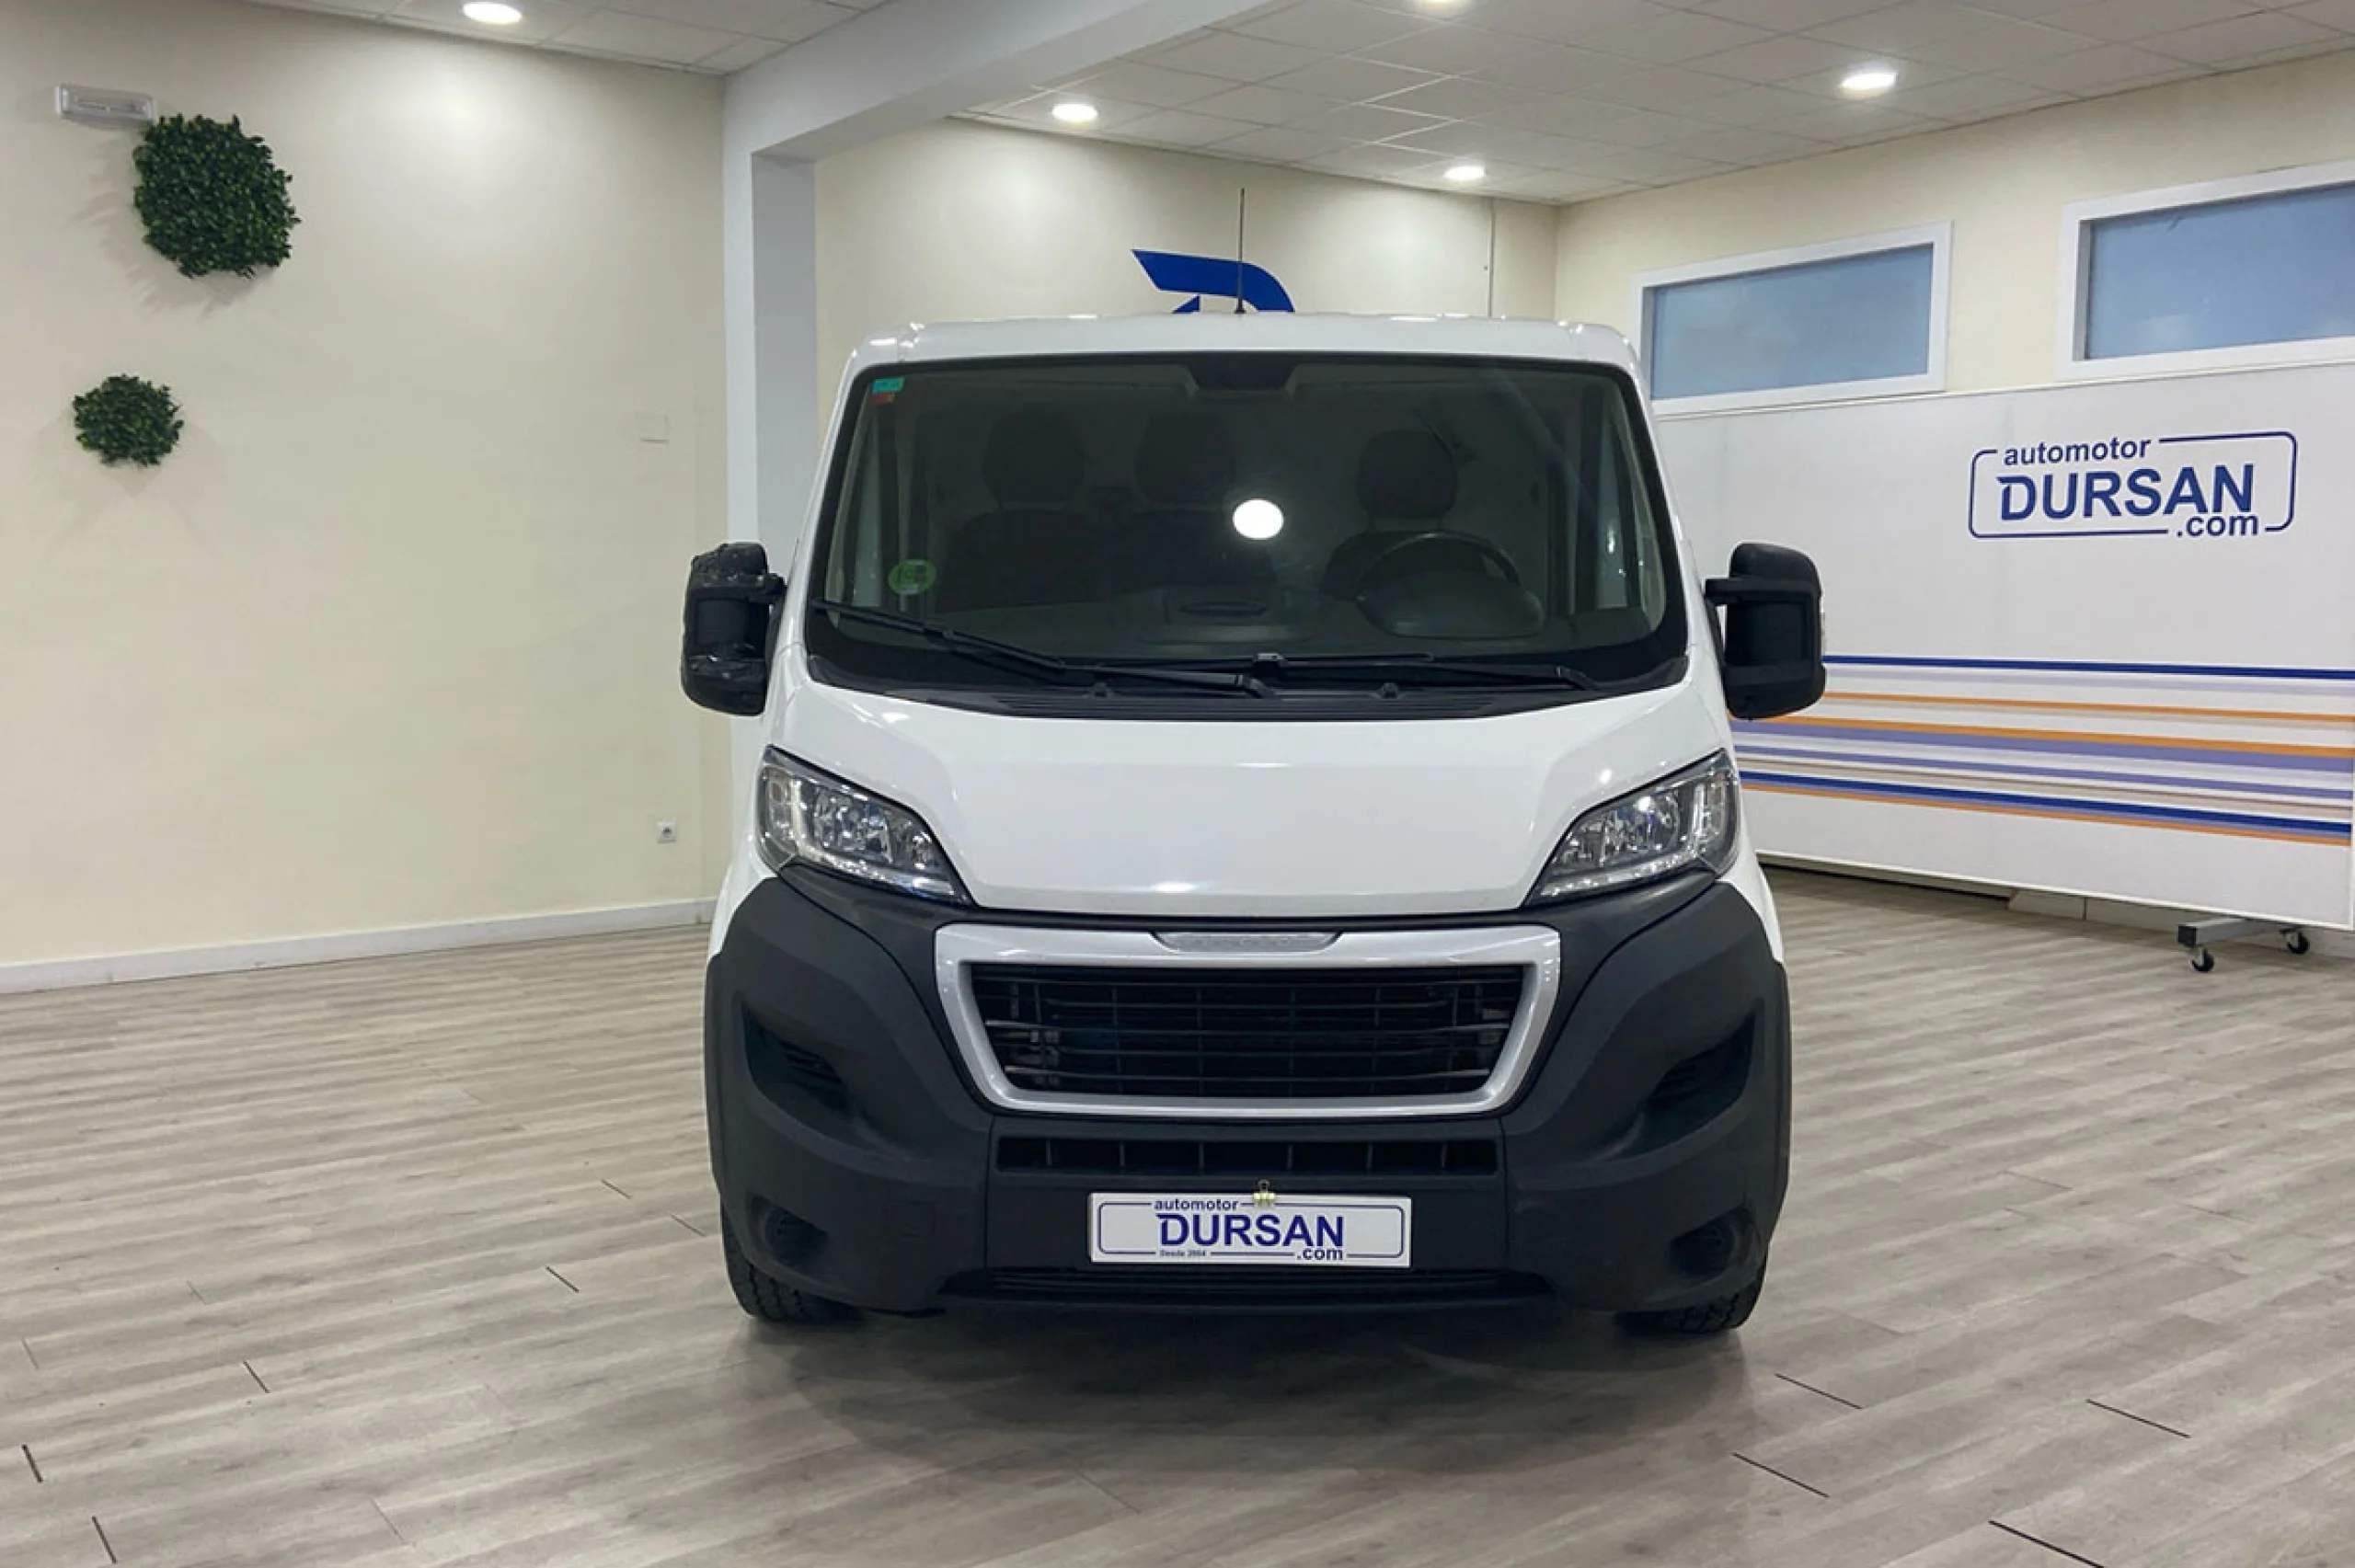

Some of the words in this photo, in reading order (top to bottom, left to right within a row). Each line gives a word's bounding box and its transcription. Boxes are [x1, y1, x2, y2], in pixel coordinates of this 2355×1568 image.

[2005, 437, 2151, 465] automotor
[1996, 464, 2254, 521] DURSAN
[2177, 513, 2258, 537] .com
[1154, 1198, 1239, 1211] automotor
[1155, 1213, 1344, 1247] DURSAN
[1297, 1246, 1343, 1261] .com
